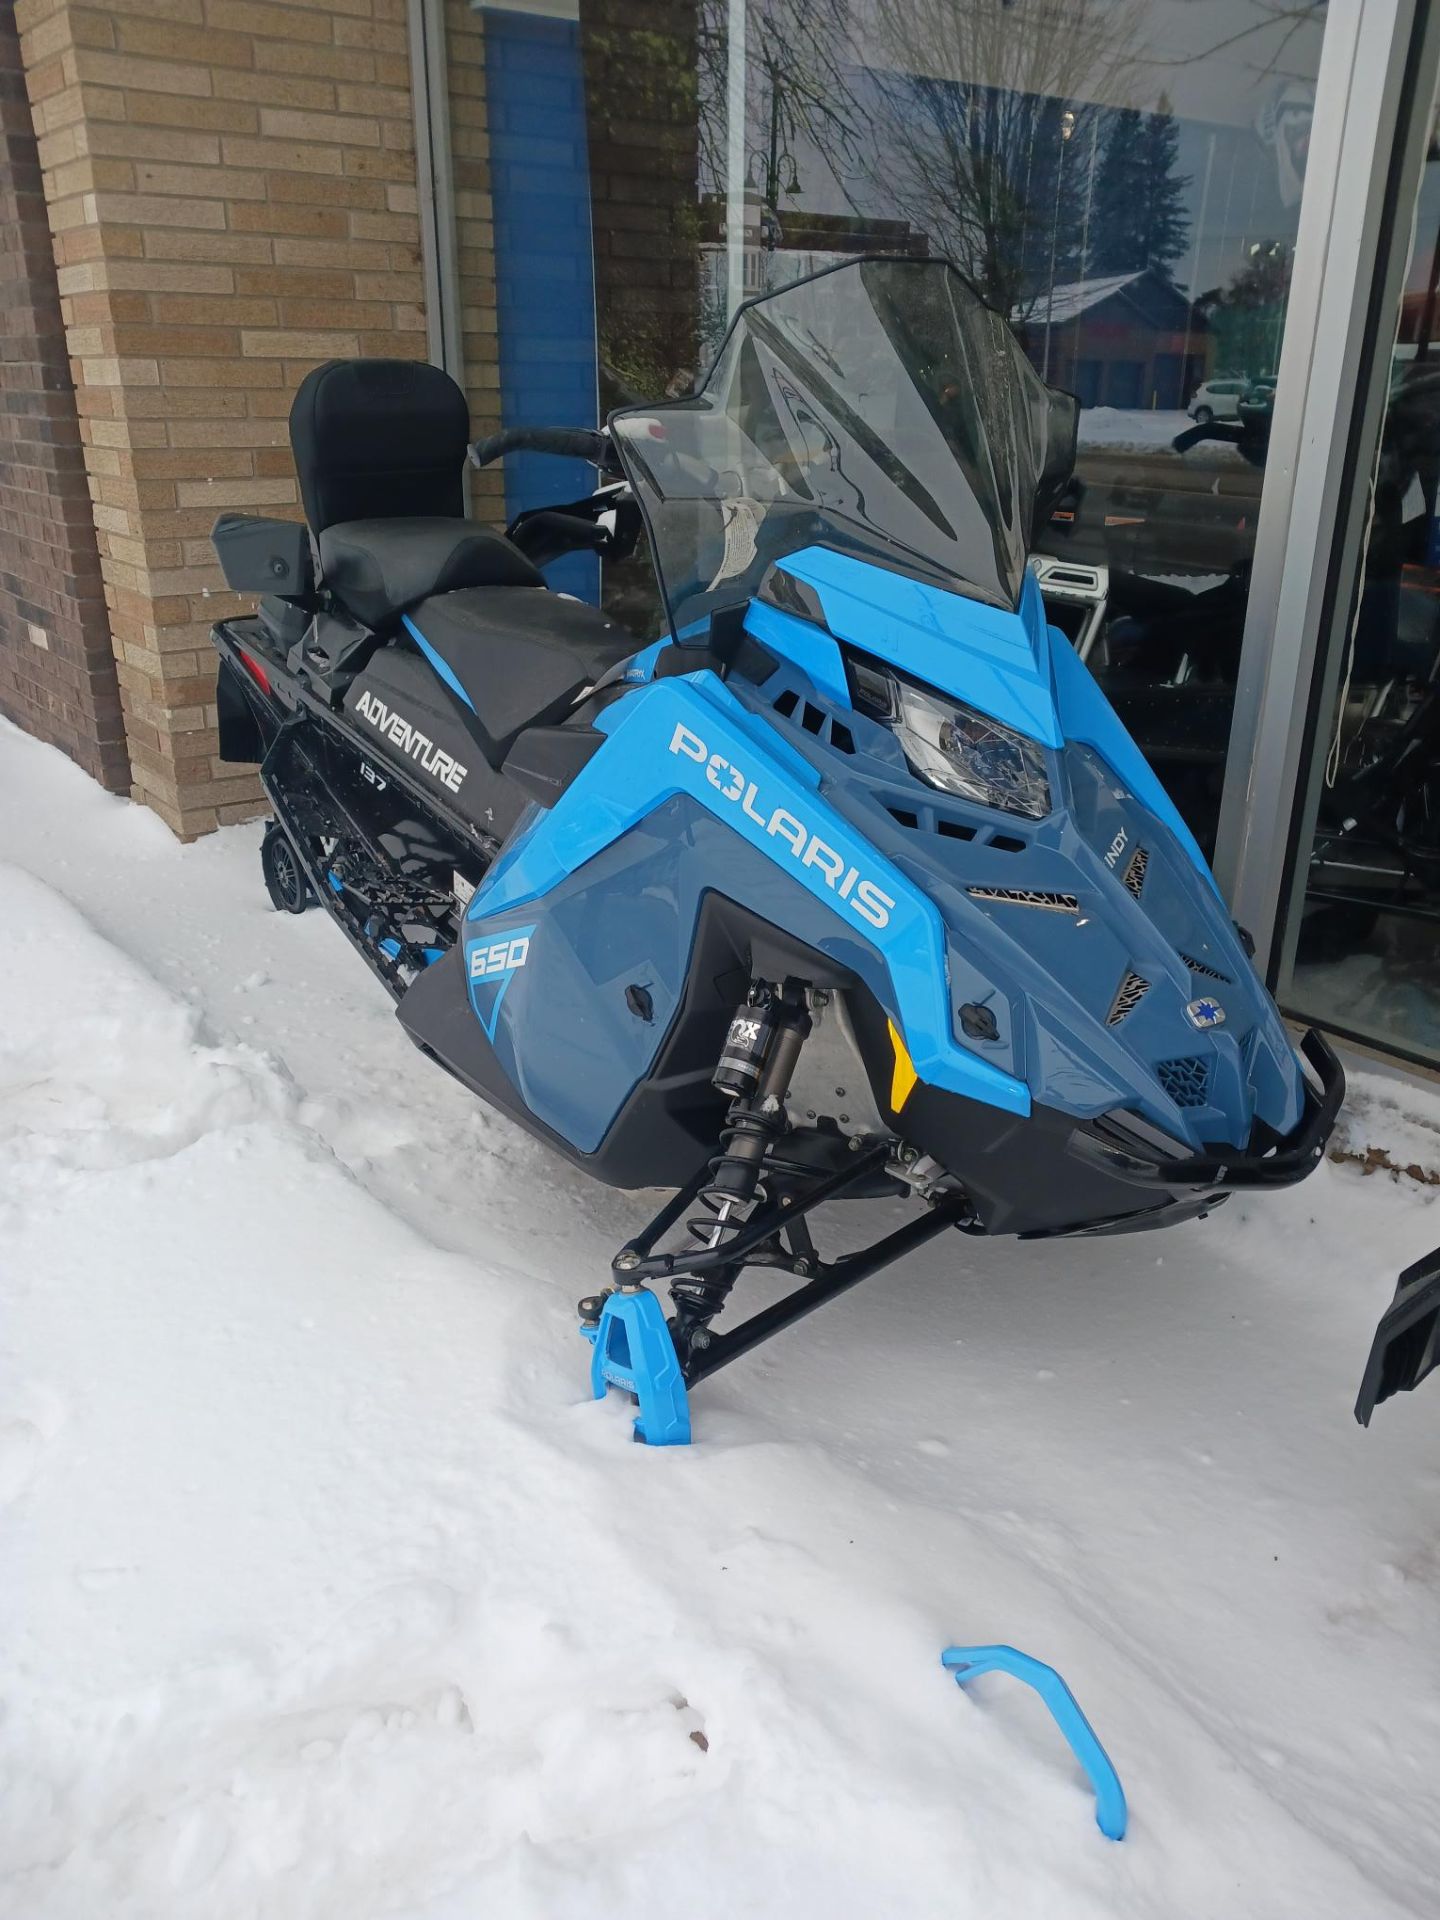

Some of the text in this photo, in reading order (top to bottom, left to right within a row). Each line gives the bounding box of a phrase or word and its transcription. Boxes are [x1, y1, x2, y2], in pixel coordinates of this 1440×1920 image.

[355, 691, 468, 793] ADVENTURE
[360, 762, 387, 791] 137
[669, 722, 896, 929] POLARIS
[1104, 827, 1128, 869] INDY
[470, 937, 530, 978] 650
